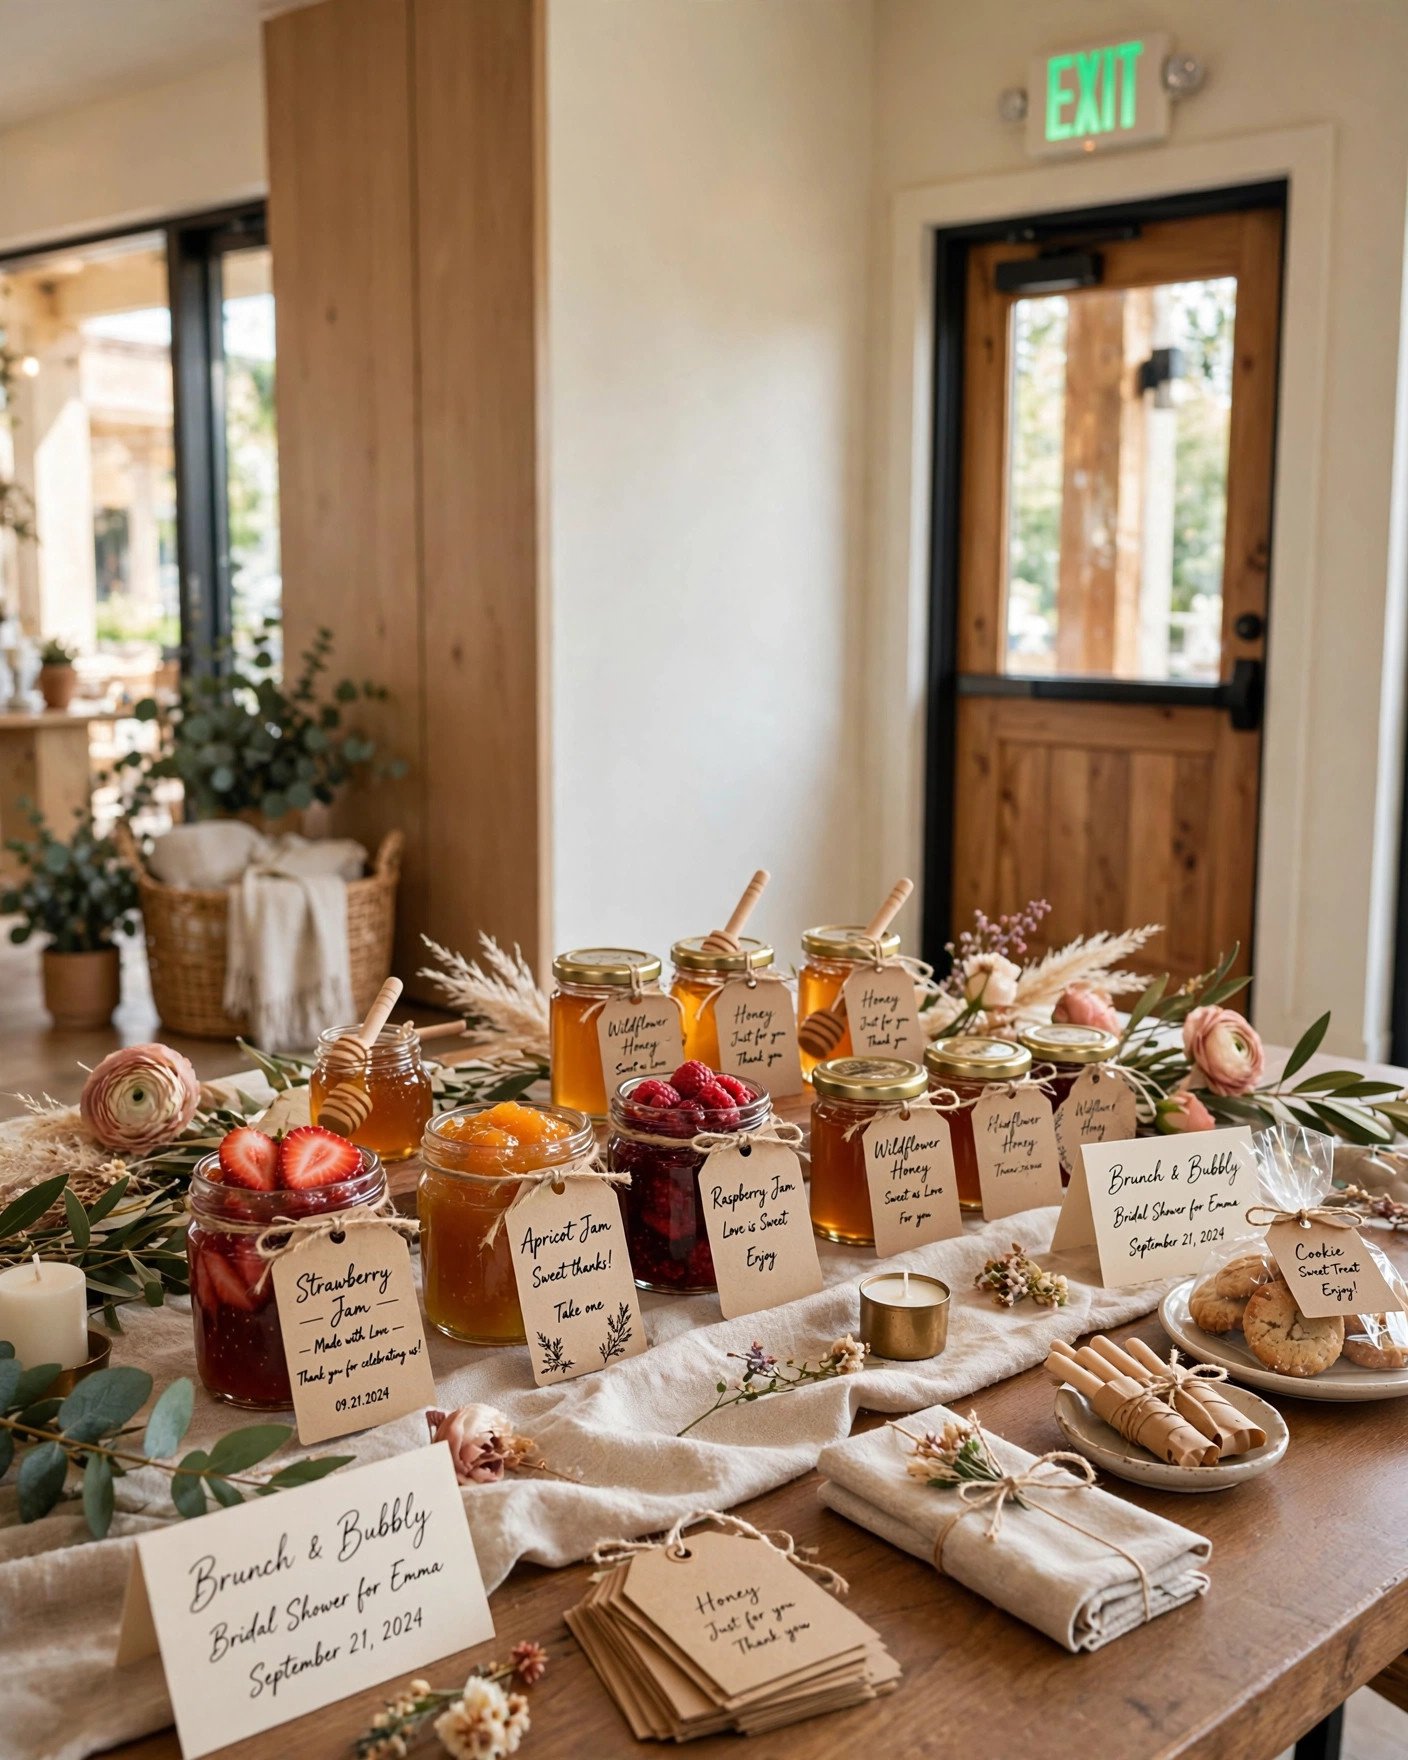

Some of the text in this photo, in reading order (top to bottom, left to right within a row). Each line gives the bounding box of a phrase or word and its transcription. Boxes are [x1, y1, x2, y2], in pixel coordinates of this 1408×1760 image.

[1045, 40, 1143, 142] EXIT
[862, 989, 899, 1012] Honey
[608, 1014, 669, 1038] Wildflower
[734, 1004, 774, 1029] Honey
[622, 1037, 659, 1058] Honey
[755, 1028, 767, 1046] for
[736, 1050, 763, 1066] Thank
[874, 1135, 941, 1161] Wildflower
[1001, 1134, 1038, 1157] Honey
[890, 1159, 932, 1183] Honey
[1108, 1151, 1241, 1196] Brunch & Bubbly
[710, 1175, 797, 1213] Raspberry Jam
[884, 1184, 944, 1205] Sweet as Love
[722, 1209, 790, 1239] Love is Sweet
[915, 1212, 932, 1228] you
[1113, 1193, 1241, 1229] Bridal Shower for Emma
[520, 1213, 612, 1260] Apricot Jam
[1128, 1227, 1226, 1259] September 21, 2024
[746, 1245, 779, 1273] Enjoy
[1295, 1242, 1345, 1261] Cookie
[296, 1262, 393, 1304] Strawberry
[532, 1249, 613, 1289] Sweet thanks!
[1298, 1261, 1361, 1278] Sweet Treat
[1321, 1280, 1359, 1302] Enjoy!
[330, 1295, 372, 1329] Jam
[553, 1298, 605, 1324] Take one
[314, 1324, 390, 1355] Made with Love
[297, 1339, 422, 1387] Thank you for celebrating us!
[335, 1386, 390, 1413] 09.21.2024
[188, 1491, 432, 1615] Brunch & Bubbly
[208, 1558, 444, 1664] Bridal Shower for Emma
[695, 1586, 761, 1615] Honey
[703, 1602, 796, 1642] Just for you
[249, 1606, 424, 1698] September 21, 2024
[731, 1621, 811, 1655] Thank you
